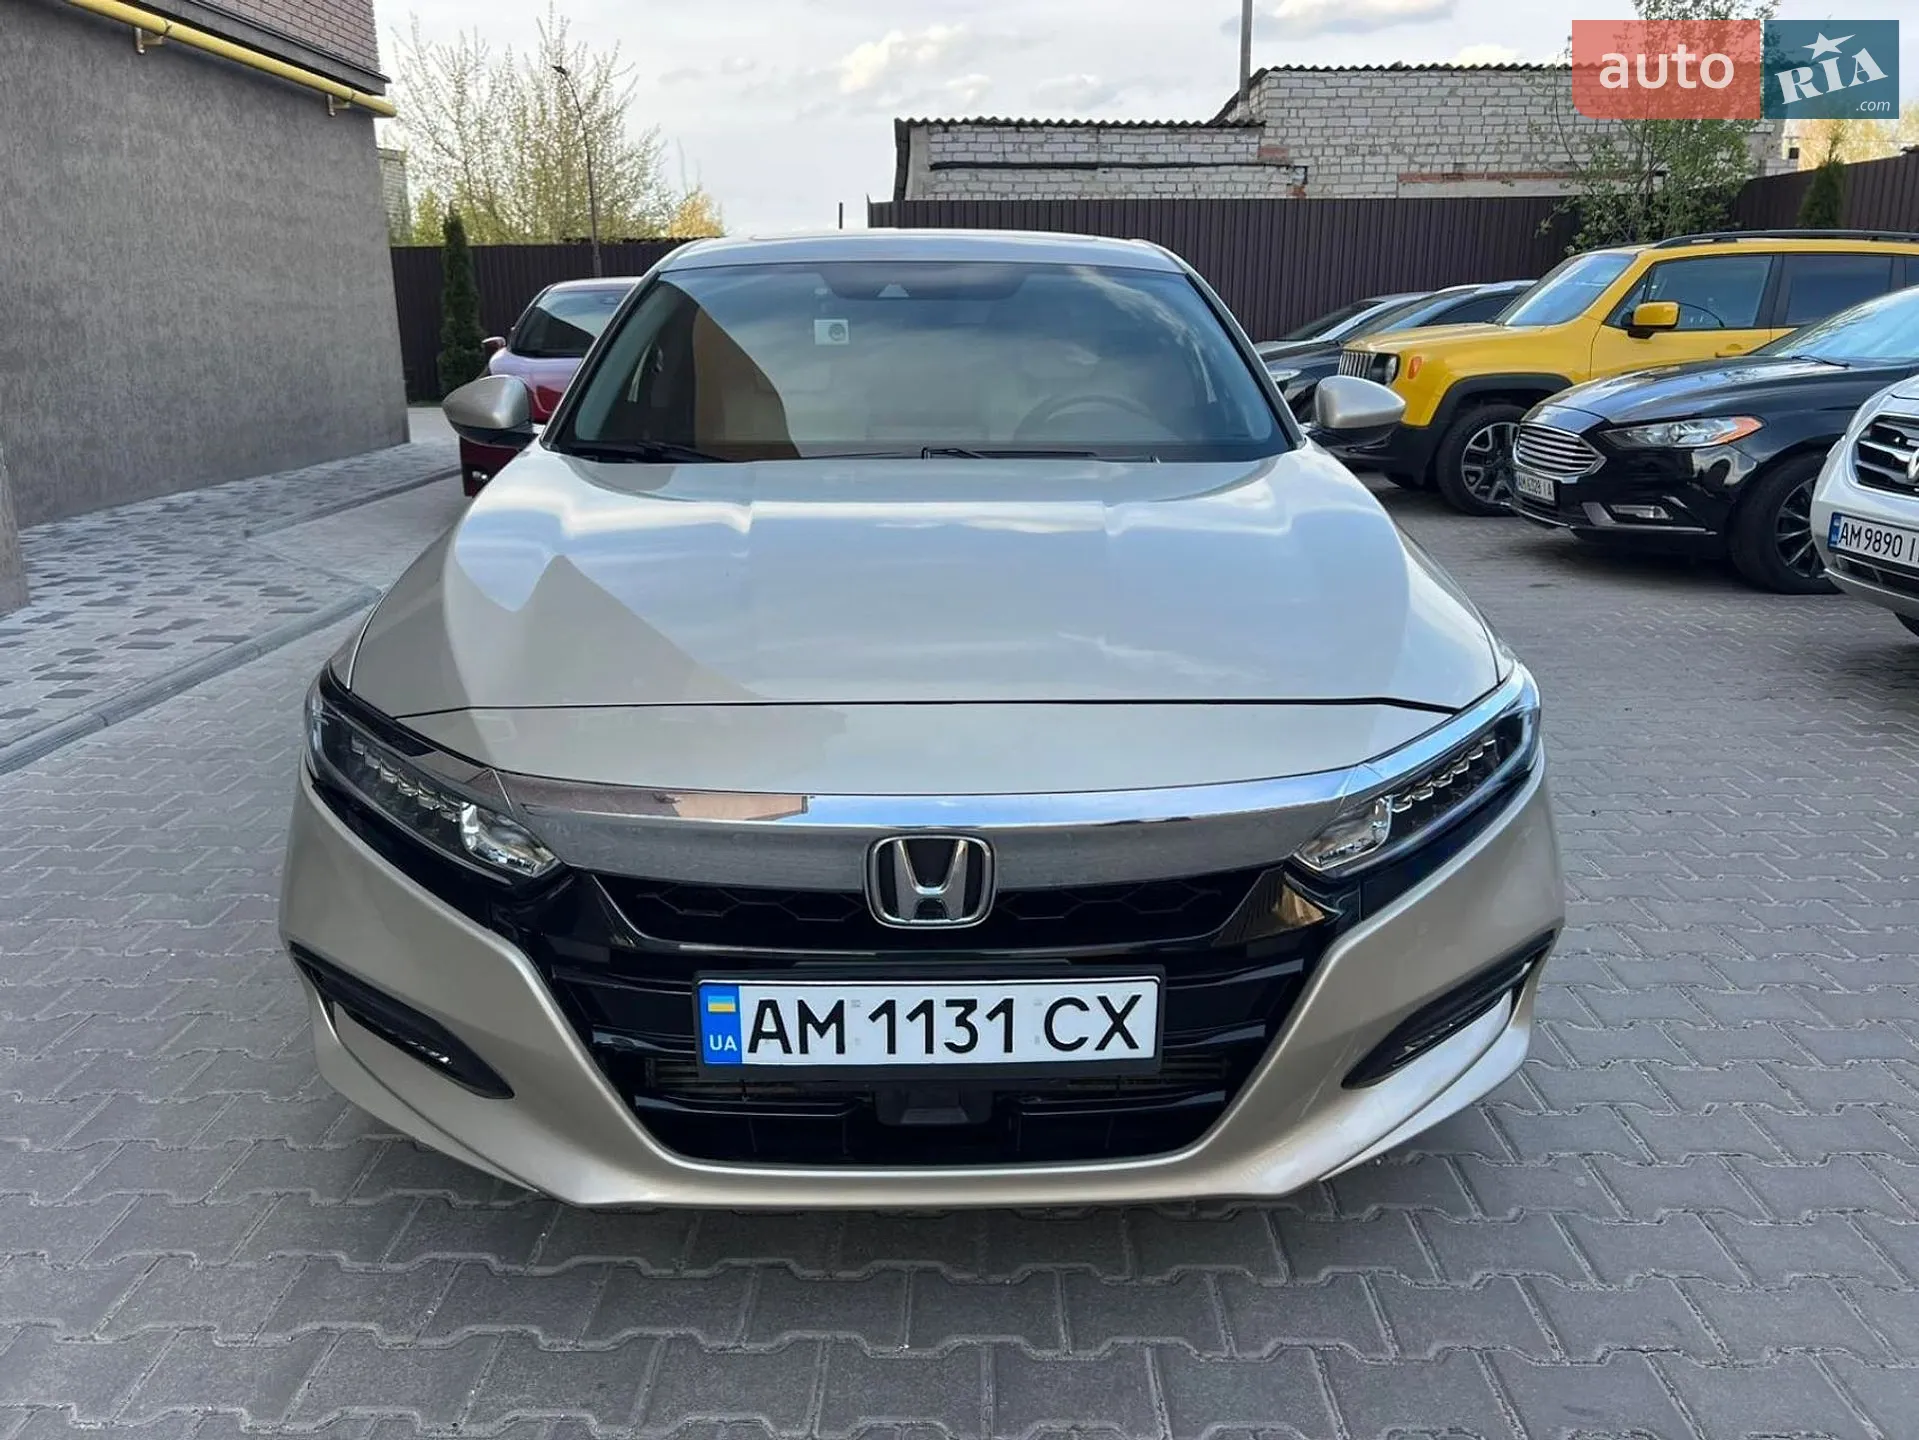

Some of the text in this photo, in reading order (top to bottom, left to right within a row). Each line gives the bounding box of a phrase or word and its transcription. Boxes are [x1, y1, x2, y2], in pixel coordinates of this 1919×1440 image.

[1839, 522, 1863, 549] AM
[1863, 528, 1903, 558] 9890
[747, 994, 1143, 1055] AM 1131 CX
[709, 1034, 738, 1052] UA
